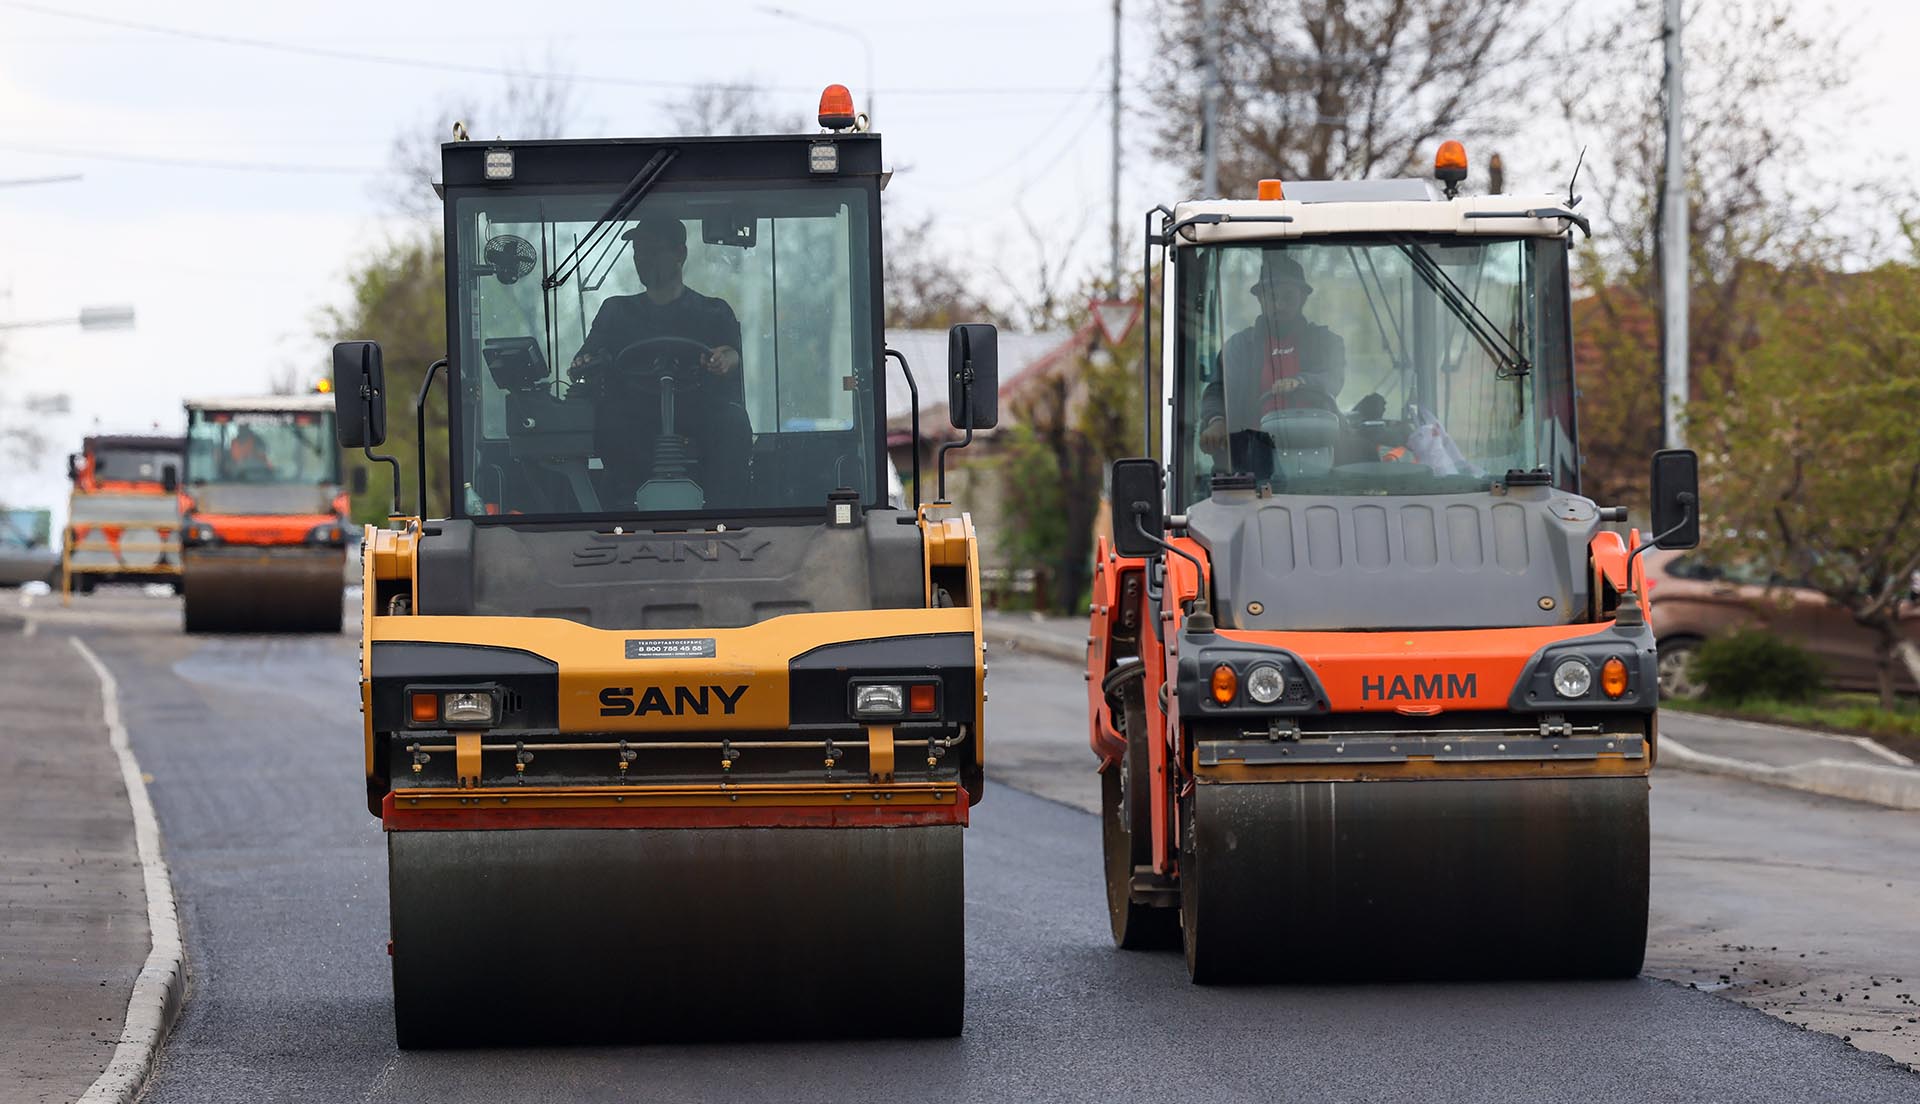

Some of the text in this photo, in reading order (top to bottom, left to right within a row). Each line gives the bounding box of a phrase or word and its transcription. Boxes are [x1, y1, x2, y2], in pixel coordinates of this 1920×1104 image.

[573, 541, 771, 567] SANY
[1362, 673, 1477, 700] HAMM
[599, 685, 749, 716] SANY
